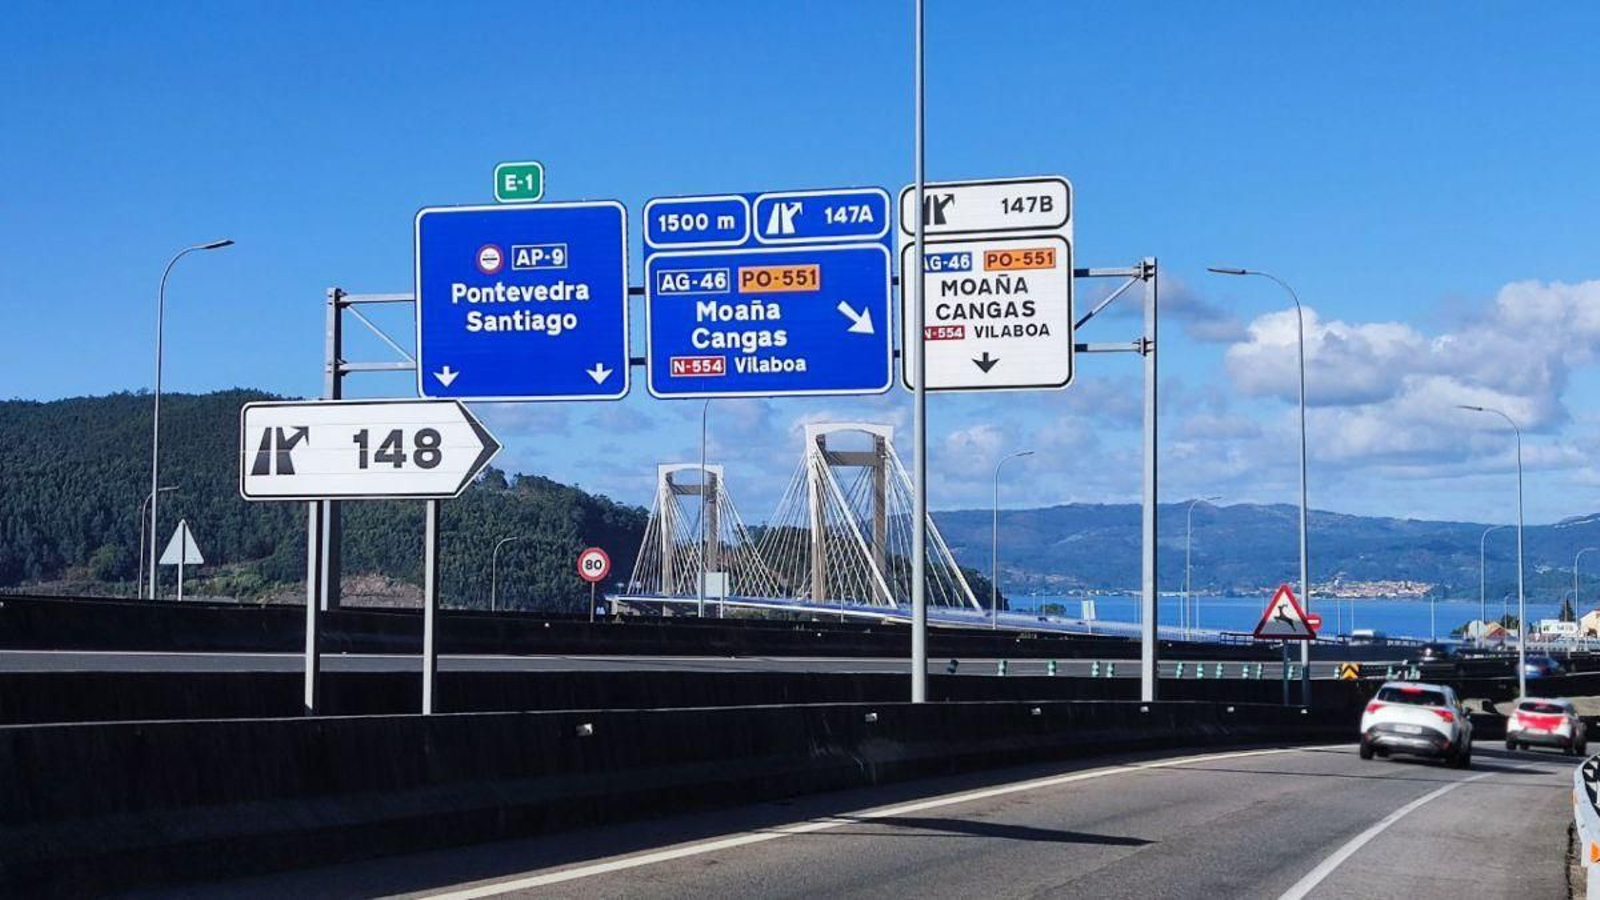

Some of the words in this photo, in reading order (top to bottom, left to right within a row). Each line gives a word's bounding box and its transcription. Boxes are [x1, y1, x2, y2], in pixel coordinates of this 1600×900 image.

[504, 174, 533, 191] E-1
[1001, 195, 1053, 214] 147B
[658, 213, 709, 232] 1500
[717, 214, 735, 229] m
[824, 205, 874, 224] 147A
[516, 249, 564, 266] AP-9
[987, 251, 1054, 268] PO-551
[661, 273, 726, 291] AG-46
[742, 269, 818, 287] PO-551
[941, 273, 1029, 297] MOAÑA
[452, 280, 590, 304] Pontevedra
[696, 300, 781, 322] Moaña
[935, 300, 1036, 321] CANGAS
[466, 310, 578, 336] Santiago
[974, 323, 1051, 339] VILABOA
[691, 327, 788, 353] Cangas
[672, 359, 724, 374] N-554
[734, 356, 807, 374] Vilaboa
[353, 428, 443, 469] 148
[585, 559, 603, 570] 80
